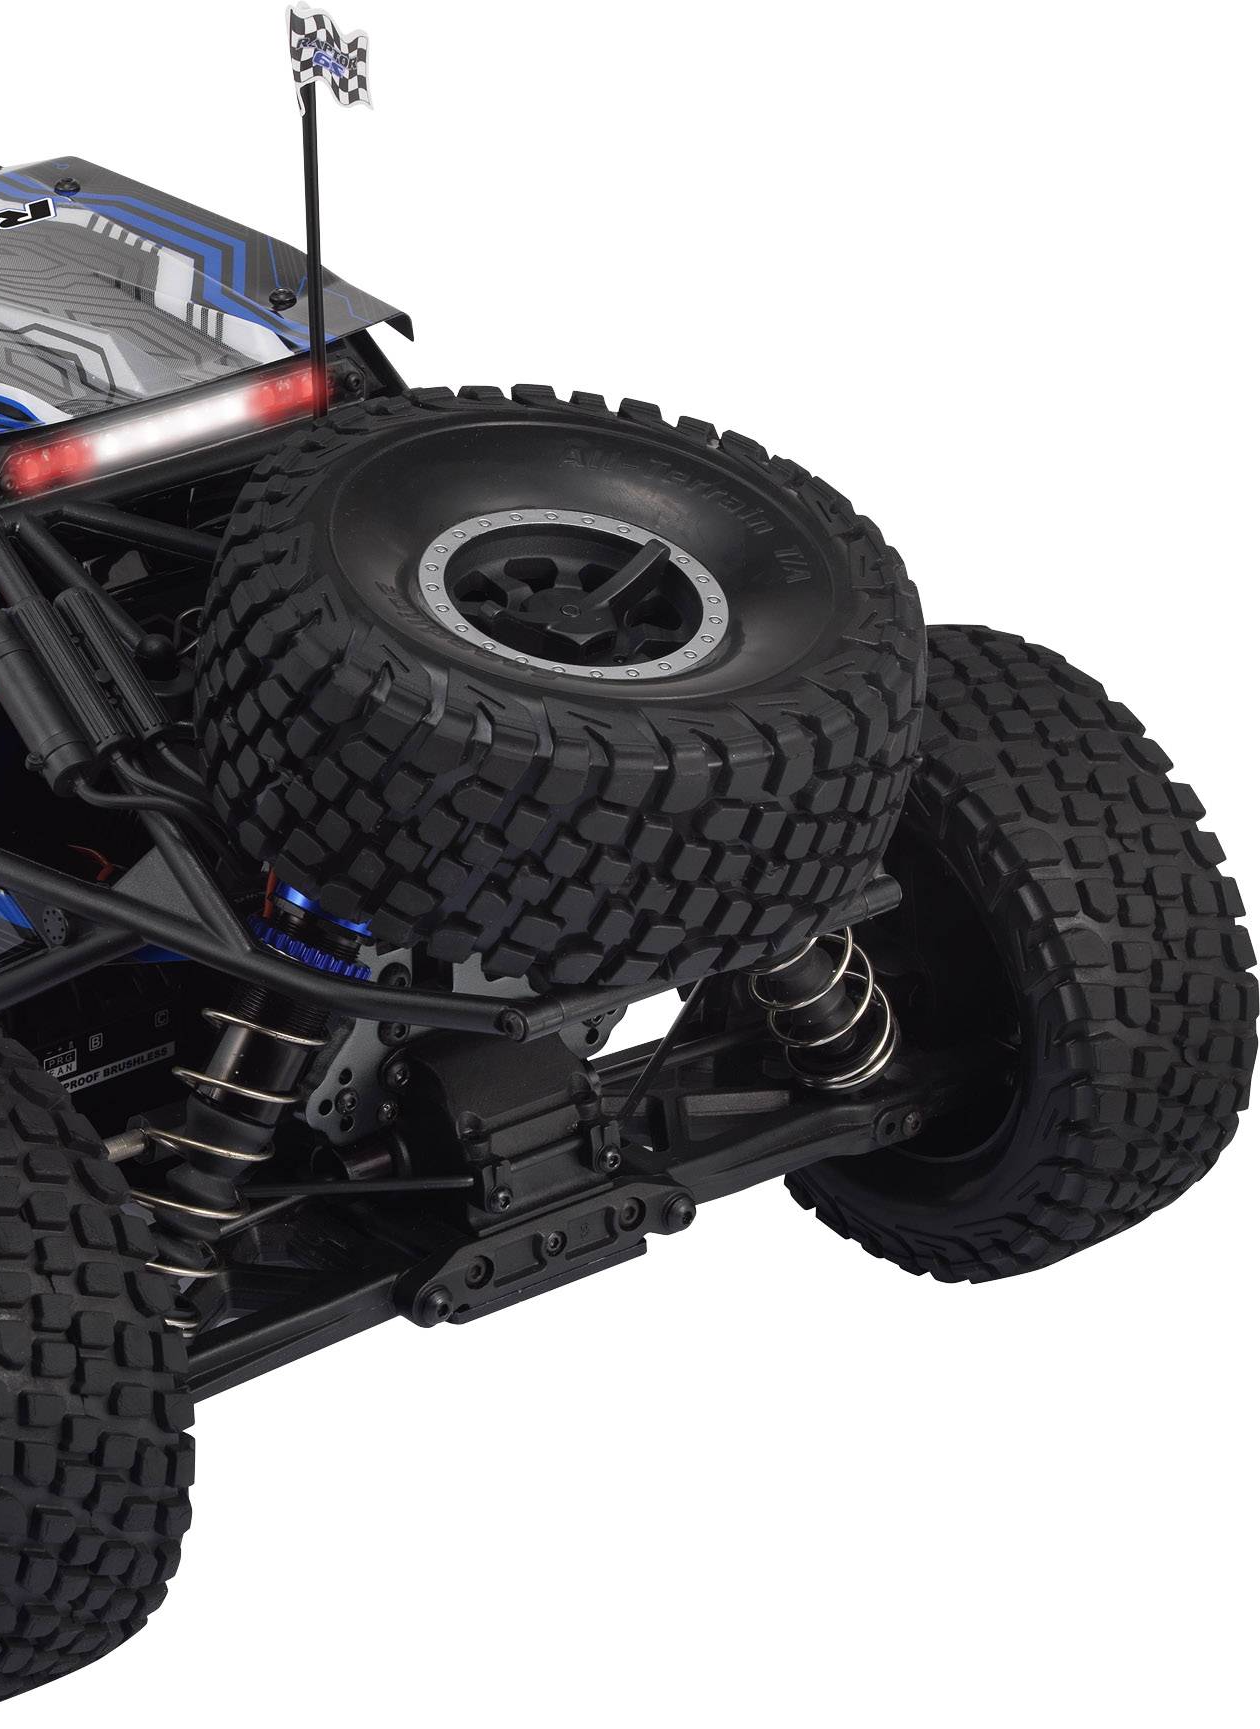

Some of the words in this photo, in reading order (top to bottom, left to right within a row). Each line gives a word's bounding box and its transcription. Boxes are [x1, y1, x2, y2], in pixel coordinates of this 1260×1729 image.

[91, 1037, 101, 1050] B
[48, 1053, 75, 1069] PRG
[103, 1047, 168, 1077] BRUSHLESS
